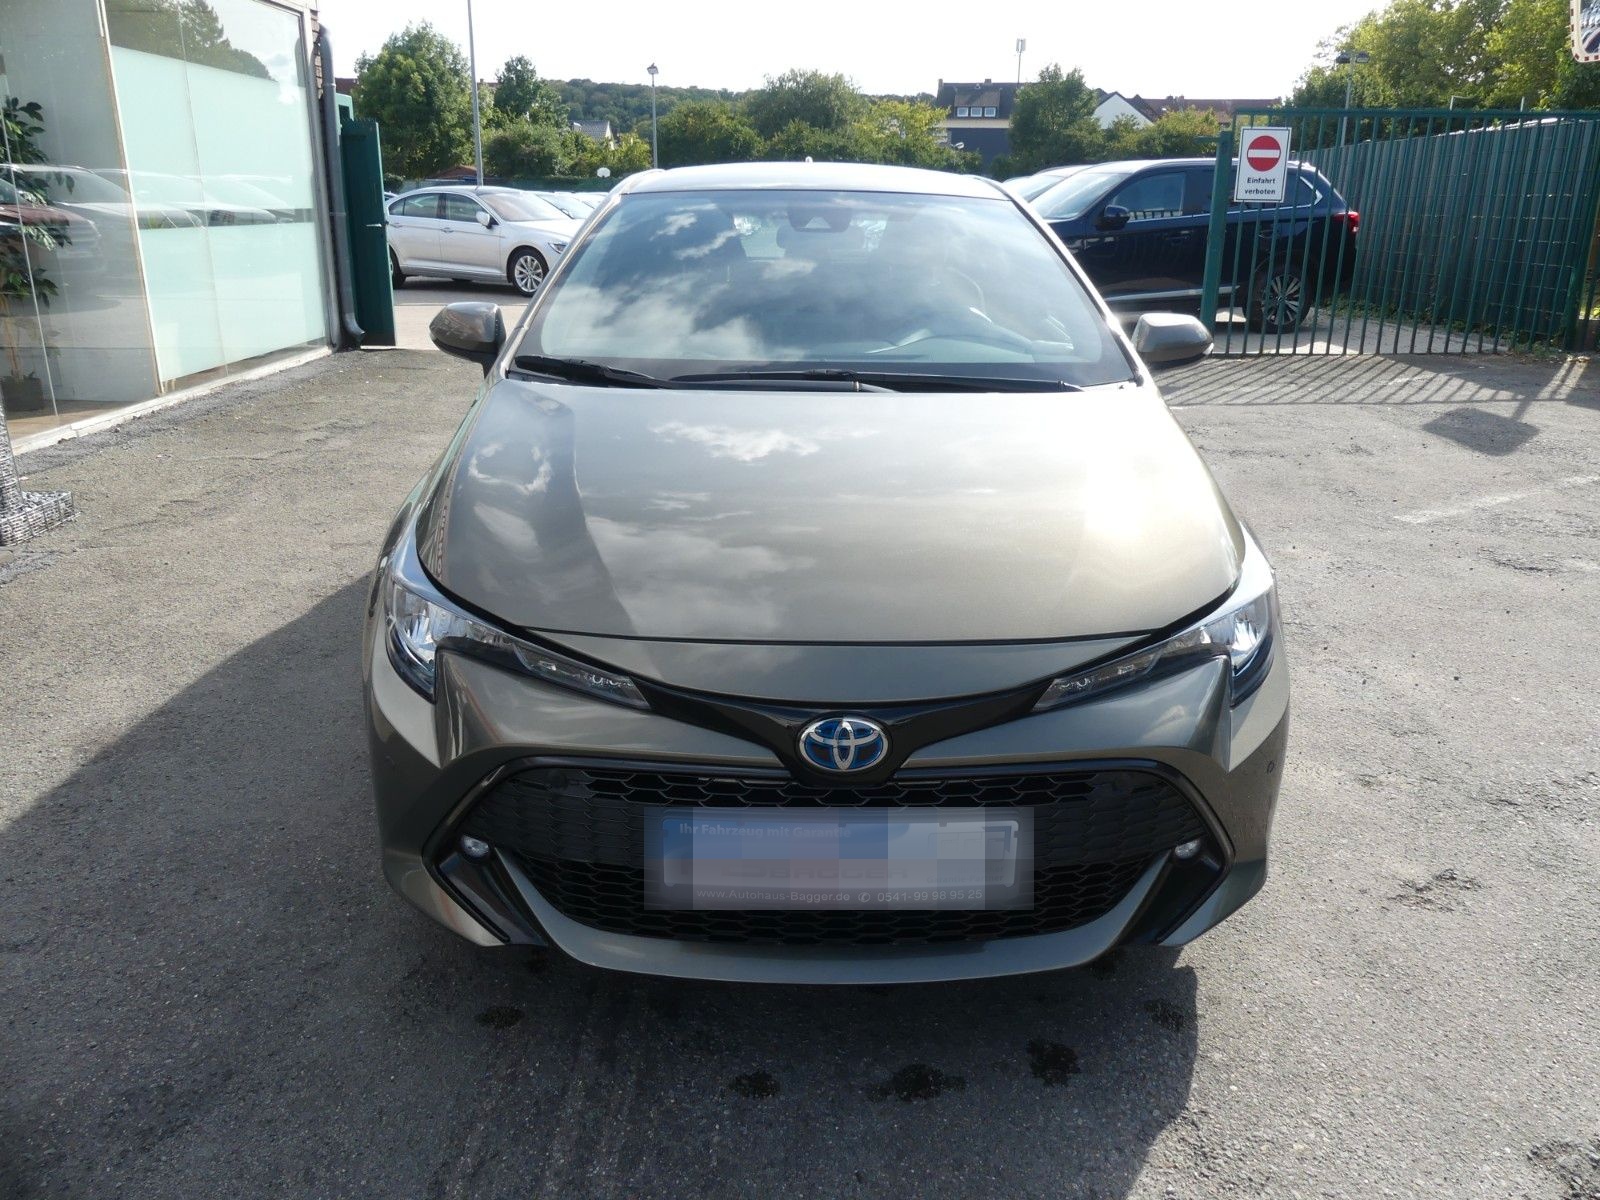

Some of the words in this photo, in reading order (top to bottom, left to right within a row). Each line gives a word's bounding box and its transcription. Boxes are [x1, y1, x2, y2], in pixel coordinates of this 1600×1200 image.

[679, 822, 698, 834] Ihr
[701, 823, 763, 838] Fahrzeug
[767, 825, 790, 837] mit
[696, 889, 850, 903] www.Autohaus-Bagger.de
[932, 890, 947, 900] 98
[950, 889, 964, 900] 95
[968, 889, 982, 899] 25
